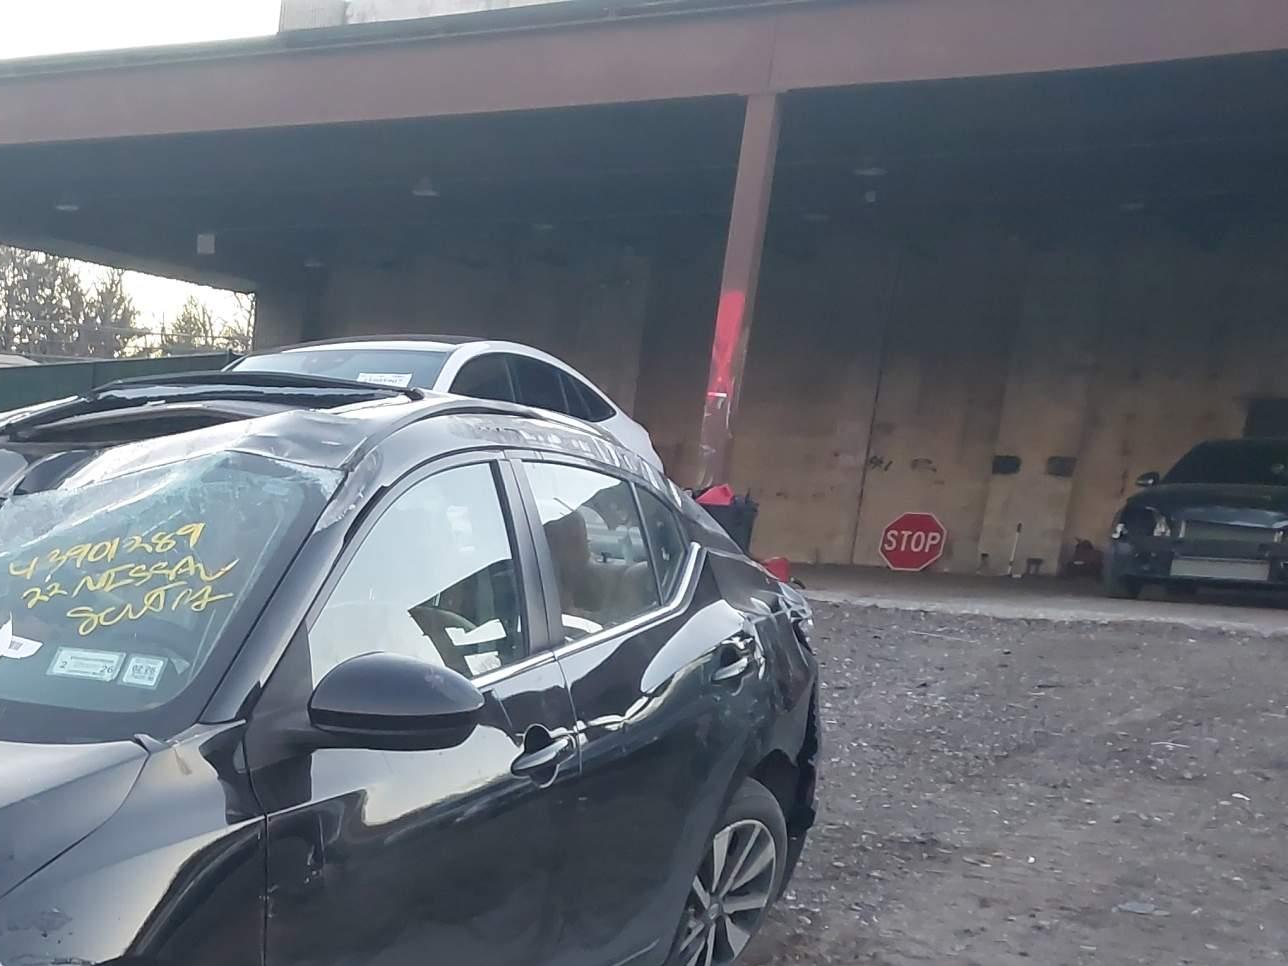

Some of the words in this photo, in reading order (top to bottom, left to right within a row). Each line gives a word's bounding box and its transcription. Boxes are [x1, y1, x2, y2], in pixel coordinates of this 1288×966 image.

[9, 522, 206, 582] 43901289
[884, 529, 941, 553] STOP
[21, 582, 68, 609] 22
